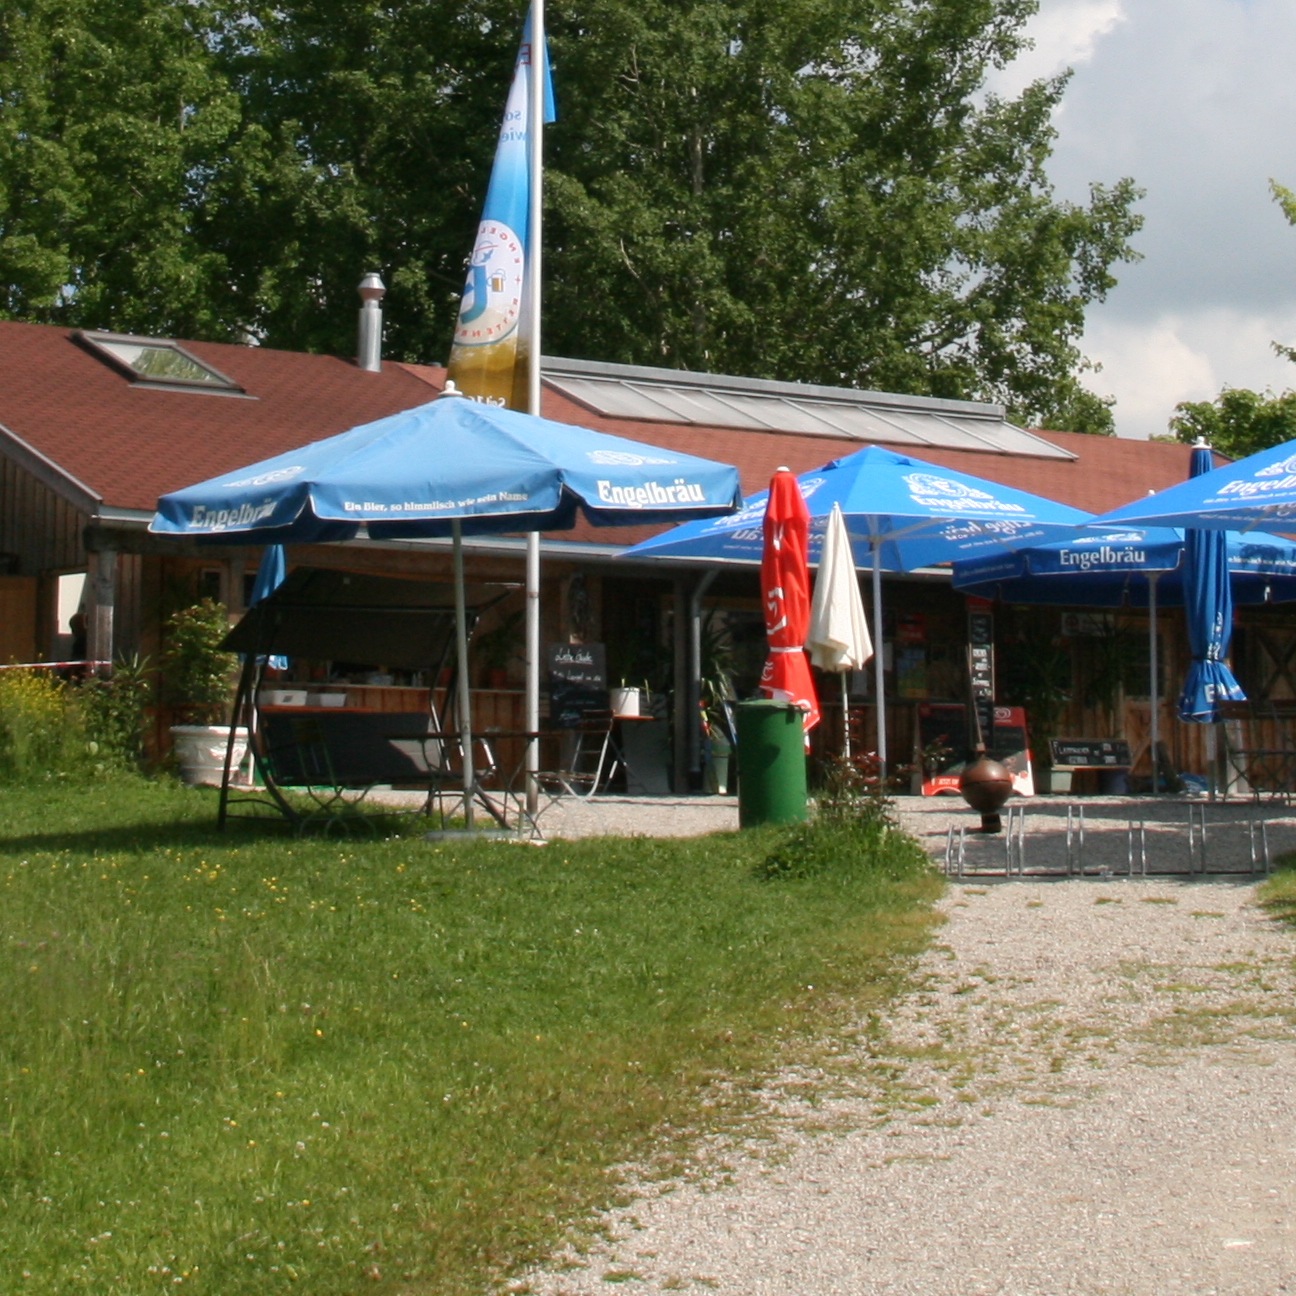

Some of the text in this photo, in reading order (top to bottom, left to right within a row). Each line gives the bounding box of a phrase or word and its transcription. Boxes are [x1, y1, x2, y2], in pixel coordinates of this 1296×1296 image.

[344, 501, 362, 511] Ein
[390, 503, 402, 511] so
[404, 500, 456, 511] himmlisch
[457, 498, 476, 507] wie
[498, 491, 528, 502] Name
[596, 479, 706, 508] Engelbräu
[909, 494, 1026, 512] Engelbräu
[189, 498, 278, 531] Engelbräu
[1059, 546, 1146, 570] Engelbräu
